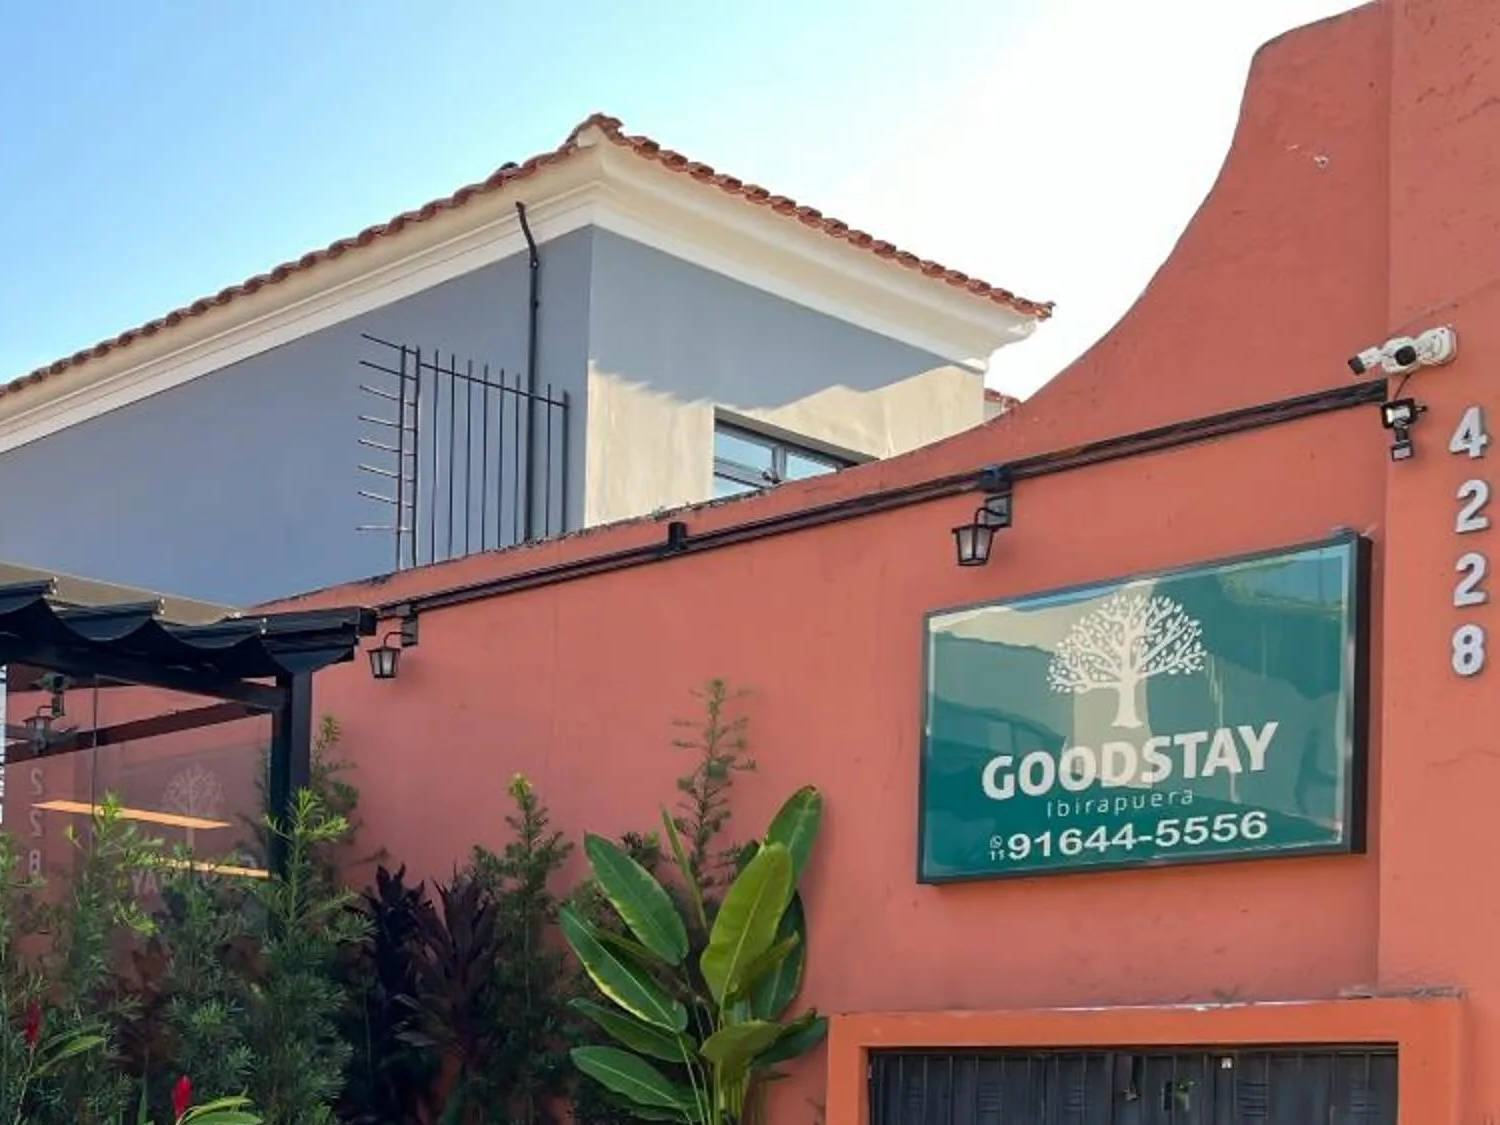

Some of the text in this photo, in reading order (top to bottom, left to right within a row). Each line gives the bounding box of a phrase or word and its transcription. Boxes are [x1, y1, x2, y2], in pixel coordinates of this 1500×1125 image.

[1449, 406, 1491, 677] 4228
[981, 721, 1280, 801] GOODSTAY
[1007, 811, 1269, 861] 91644-5556
